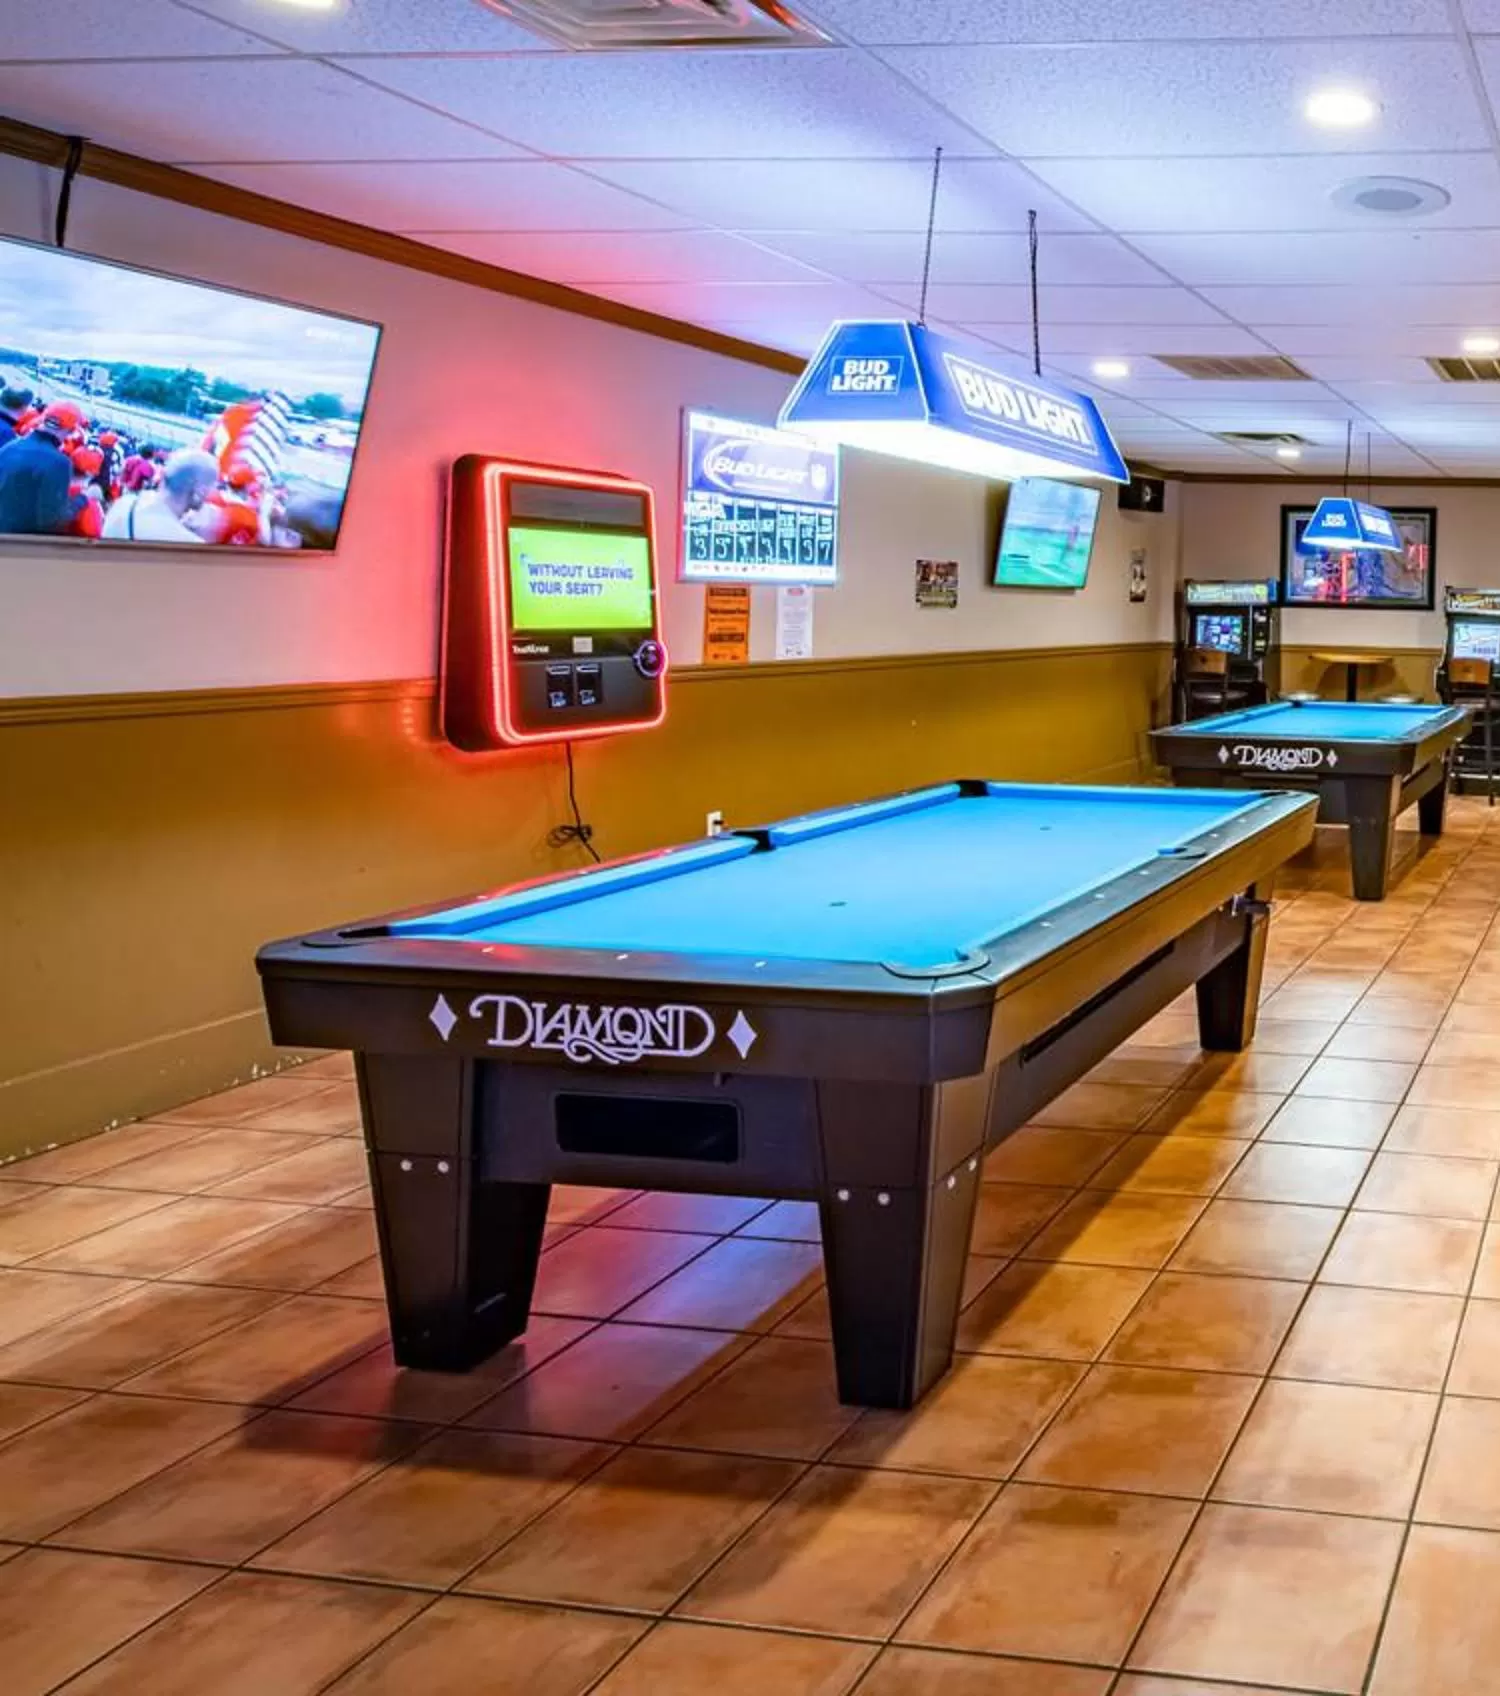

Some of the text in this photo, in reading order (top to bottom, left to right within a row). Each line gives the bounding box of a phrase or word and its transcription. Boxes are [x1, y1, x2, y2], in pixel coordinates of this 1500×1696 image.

[843, 360, 889, 375] BUD
[831, 375, 897, 391] LIGHT
[953, 367, 1090, 444] BUD LIGHT
[528, 563, 633, 580] WITHOUT LEAVING
[529, 582, 562, 594] YOUR
[1233, 745, 1324, 771] DIAMOND
[469, 994, 715, 1065] DIAMOND
